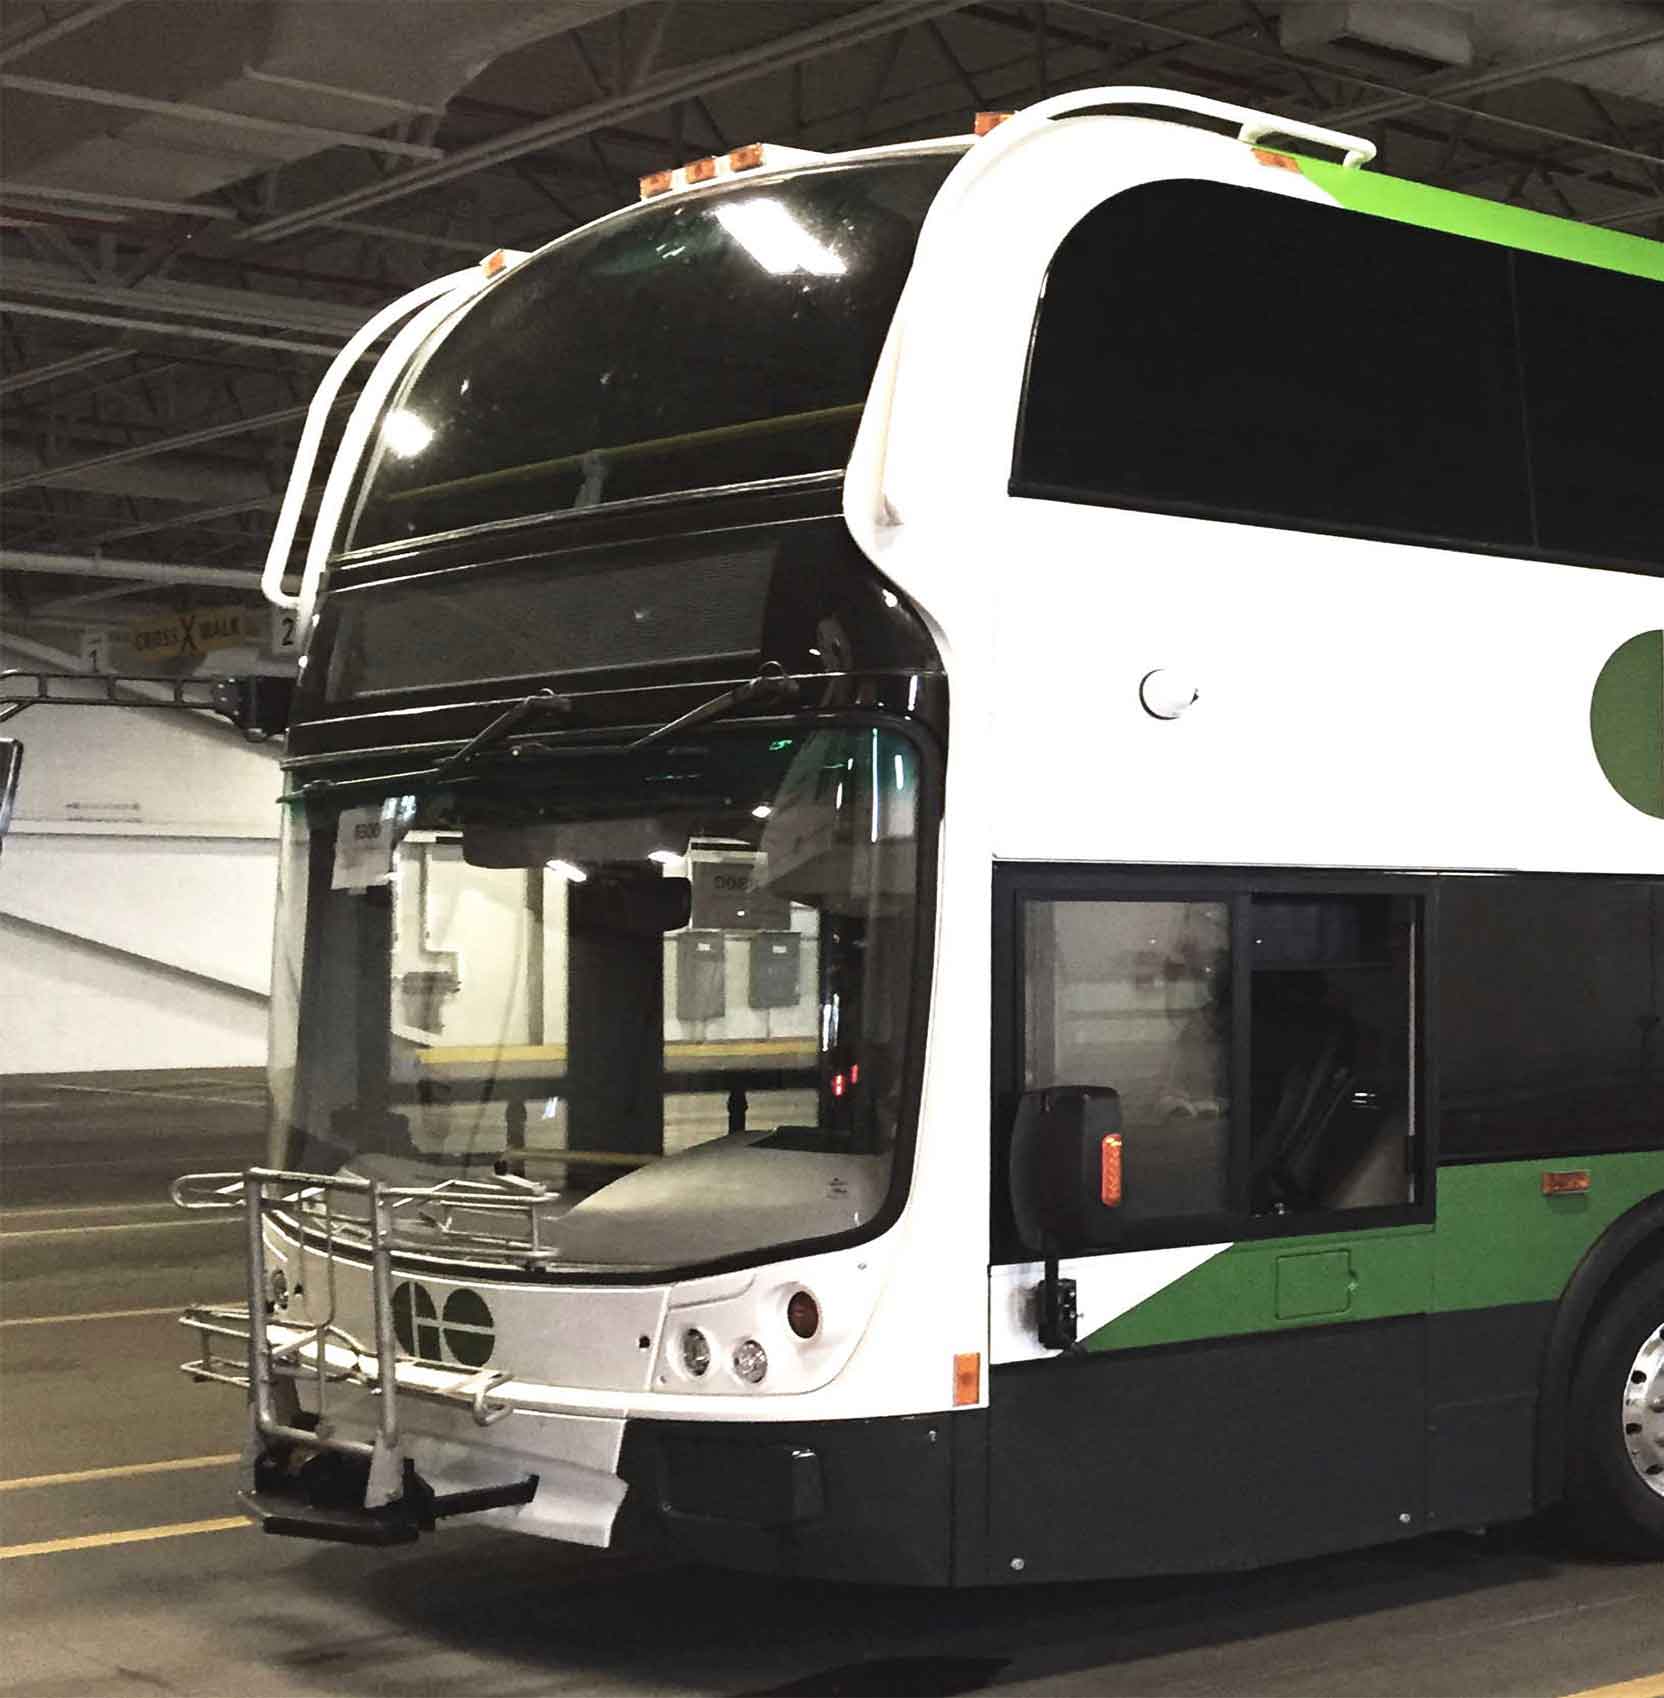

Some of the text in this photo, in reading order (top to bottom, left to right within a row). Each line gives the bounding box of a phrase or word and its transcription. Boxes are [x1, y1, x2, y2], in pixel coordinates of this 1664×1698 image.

[179, 615, 198, 656] X
[281, 616, 294, 647] 2
[392, 1280, 496, 1370] GO
